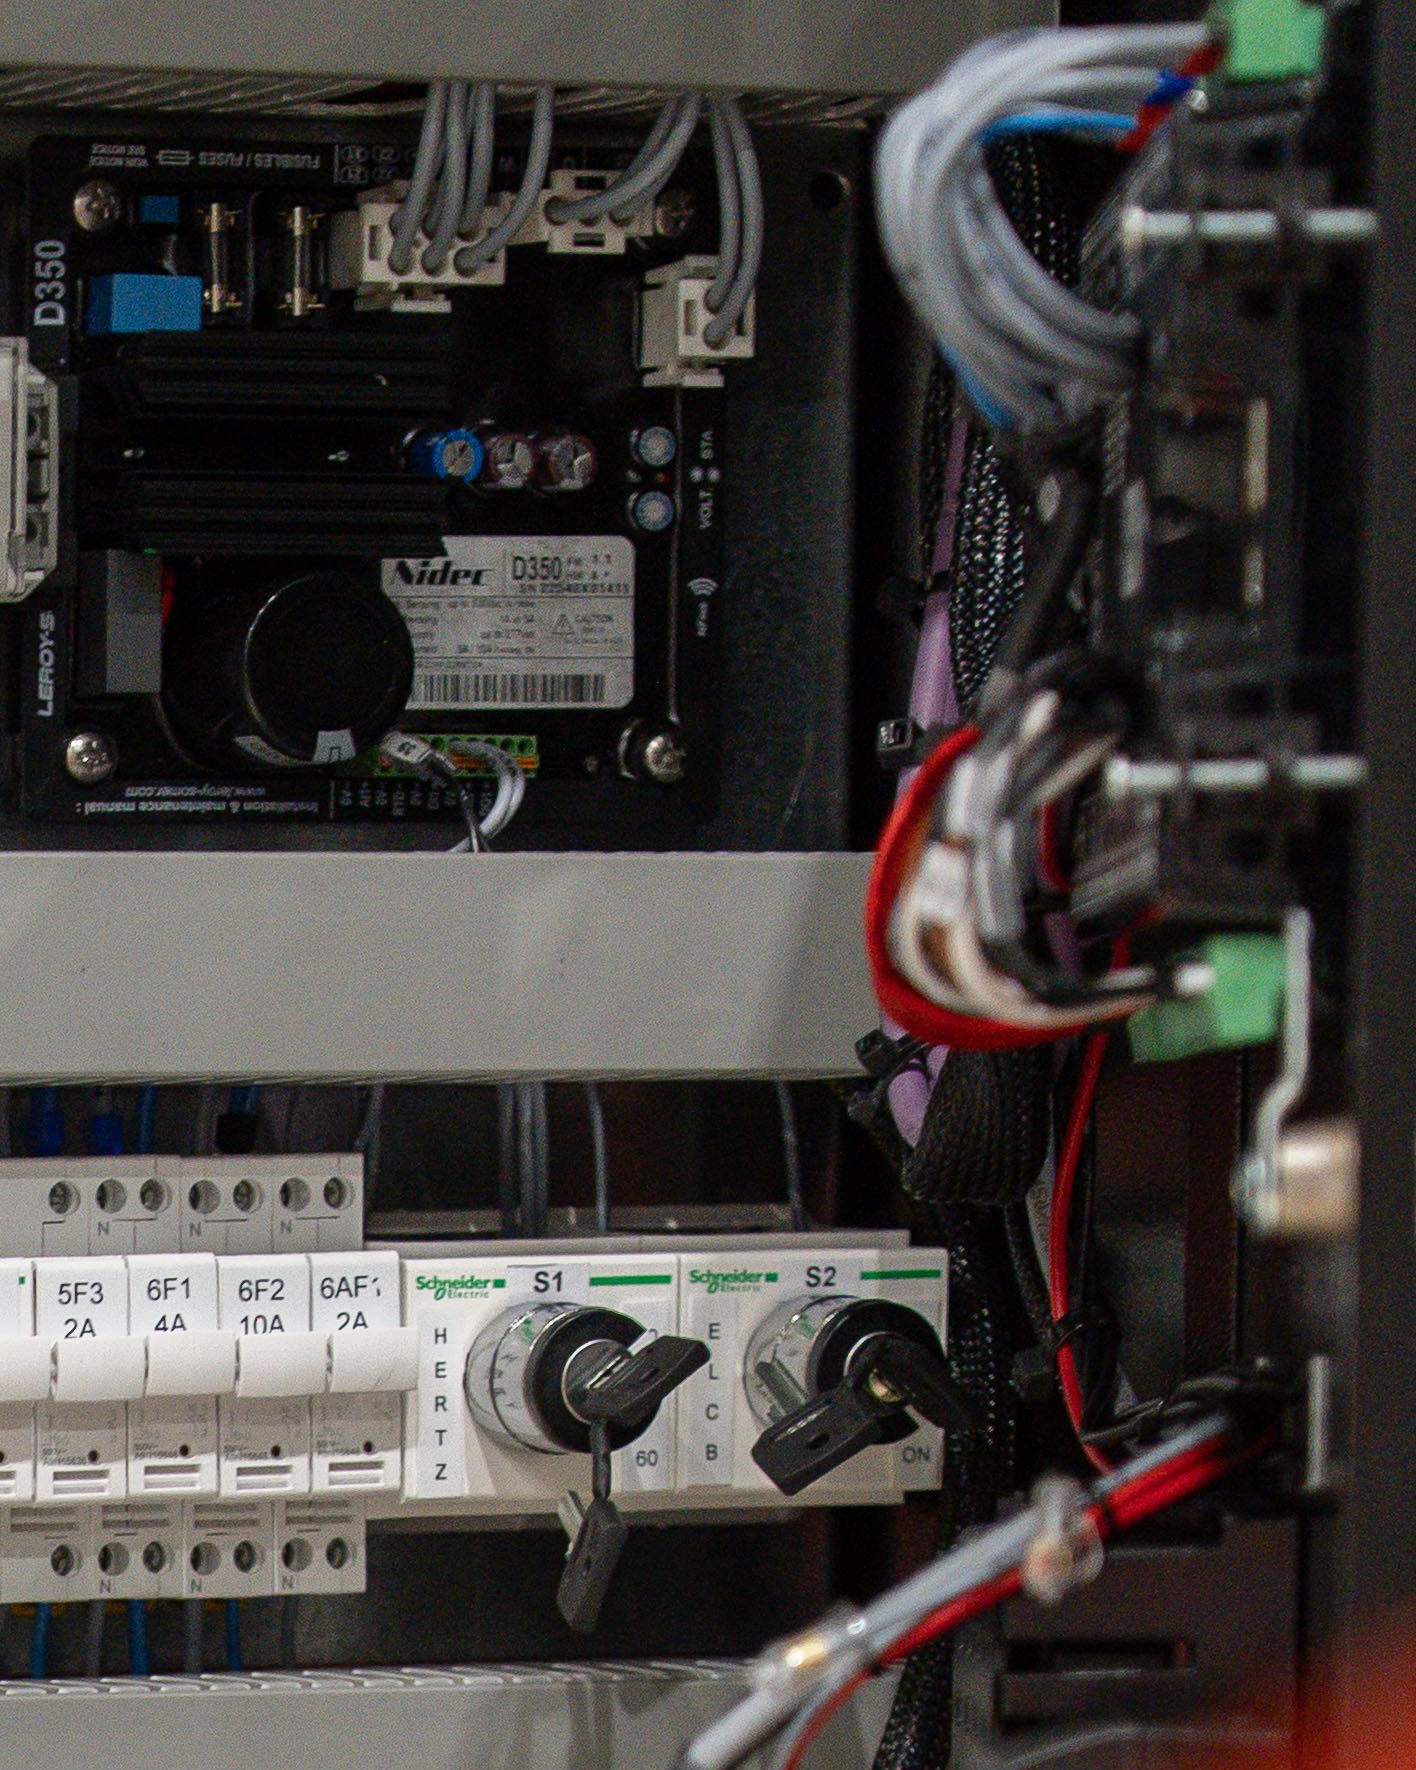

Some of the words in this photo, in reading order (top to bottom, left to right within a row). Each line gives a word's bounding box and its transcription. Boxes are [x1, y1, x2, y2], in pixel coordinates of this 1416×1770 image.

[199, 151, 244, 166] FUSES
[254, 153, 321, 168] FUSIBLES
[33, 239, 65, 326] D350
[392, 557, 494, 585] Nidec
[512, 555, 562, 581] D350
[416, 1274, 492, 1293] Schneider
[534, 1271, 562, 1293] S1
[690, 1269, 764, 1288] Schneider
[806, 1266, 836, 1288] S2
[58, 1282, 104, 1305] 5F3
[147, 1277, 190, 1301] 6F1
[238, 1278, 284, 1302] 6F2
[447, 1288, 489, 1299] Electric
[64, 1318, 96, 1339] 2A
[154, 1313, 186, 1331] 4A
[240, 1314, 284, 1334] 10A
[337, 1311, 368, 1330] 2A
[635, 1450, 658, 1467] 60
[902, 1445, 931, 1463] ON
